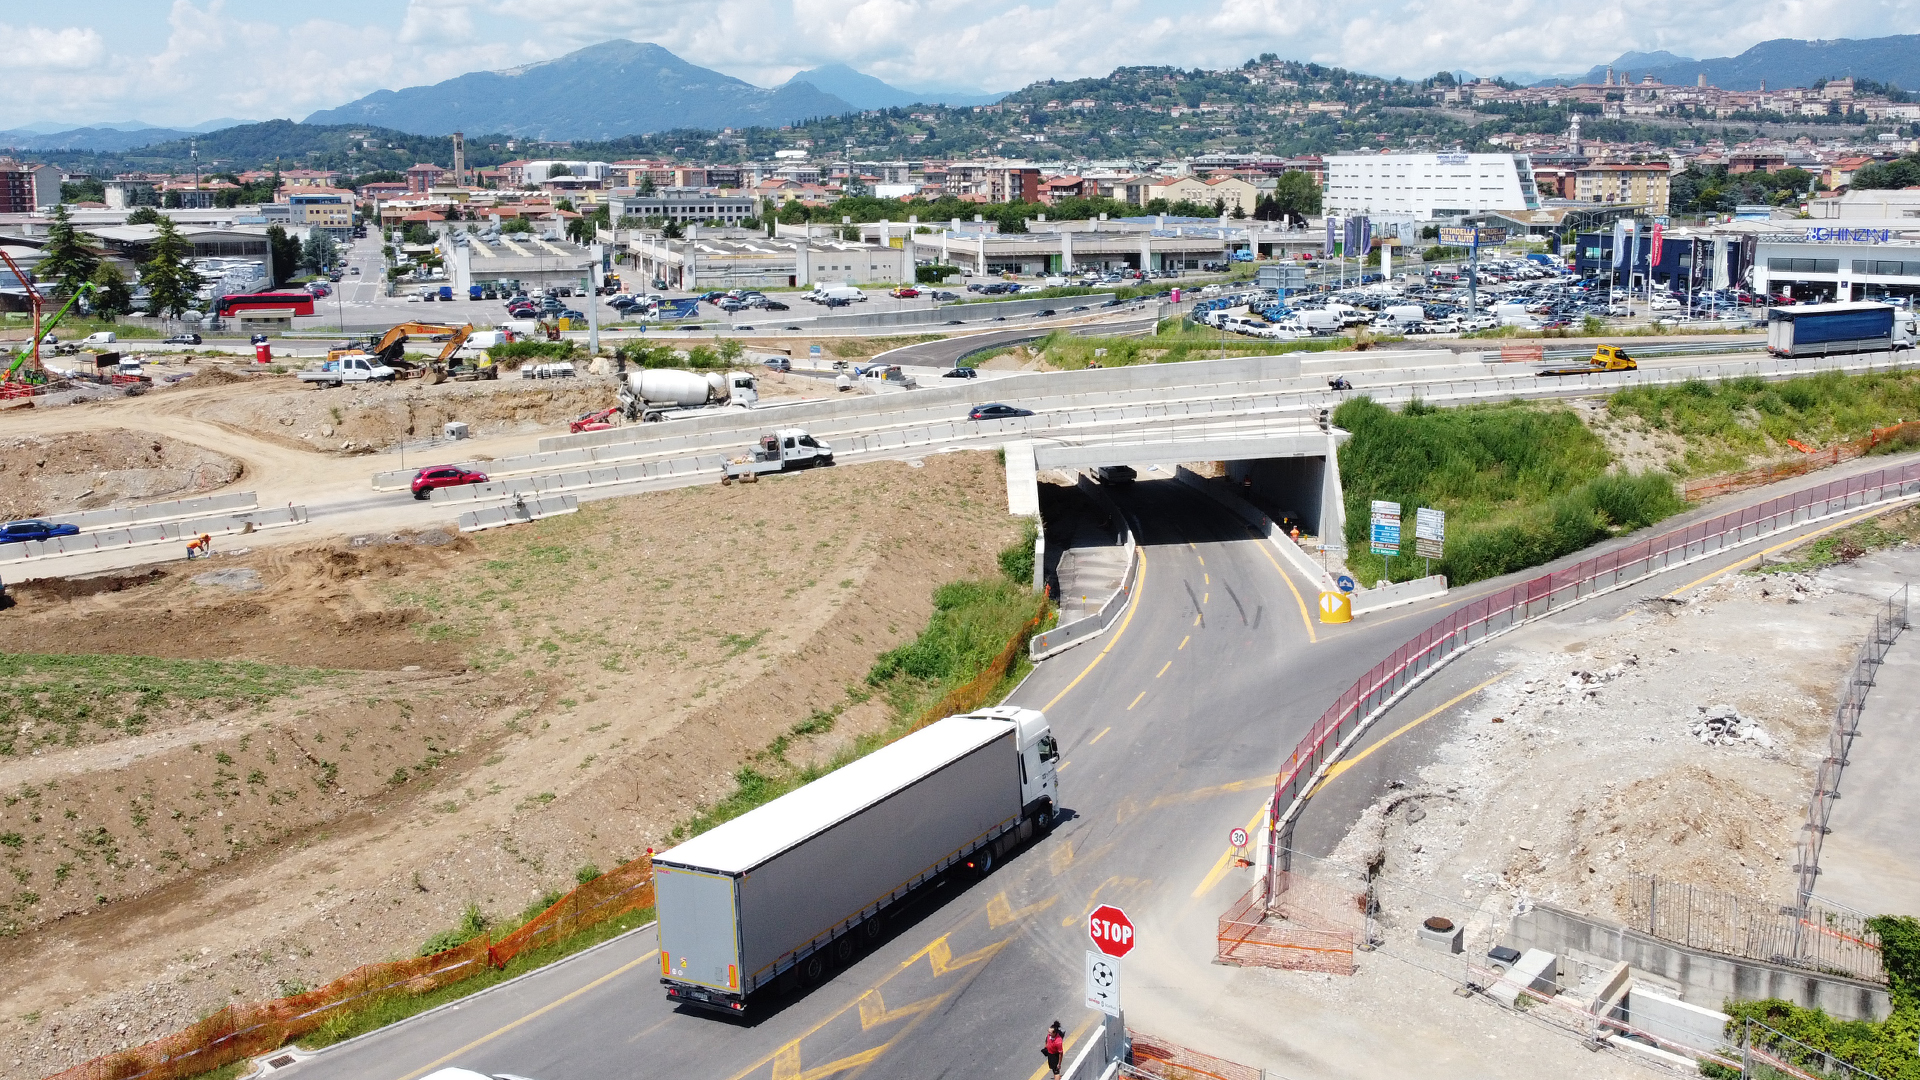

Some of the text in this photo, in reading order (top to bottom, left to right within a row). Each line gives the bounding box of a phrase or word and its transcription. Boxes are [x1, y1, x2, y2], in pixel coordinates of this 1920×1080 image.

[1440, 228, 1475, 236] CITTADELLA
[1817, 227, 1889, 242] GHINZANI
[1233, 832, 1245, 843] 30
[1091, 918, 1133, 945] STOP
